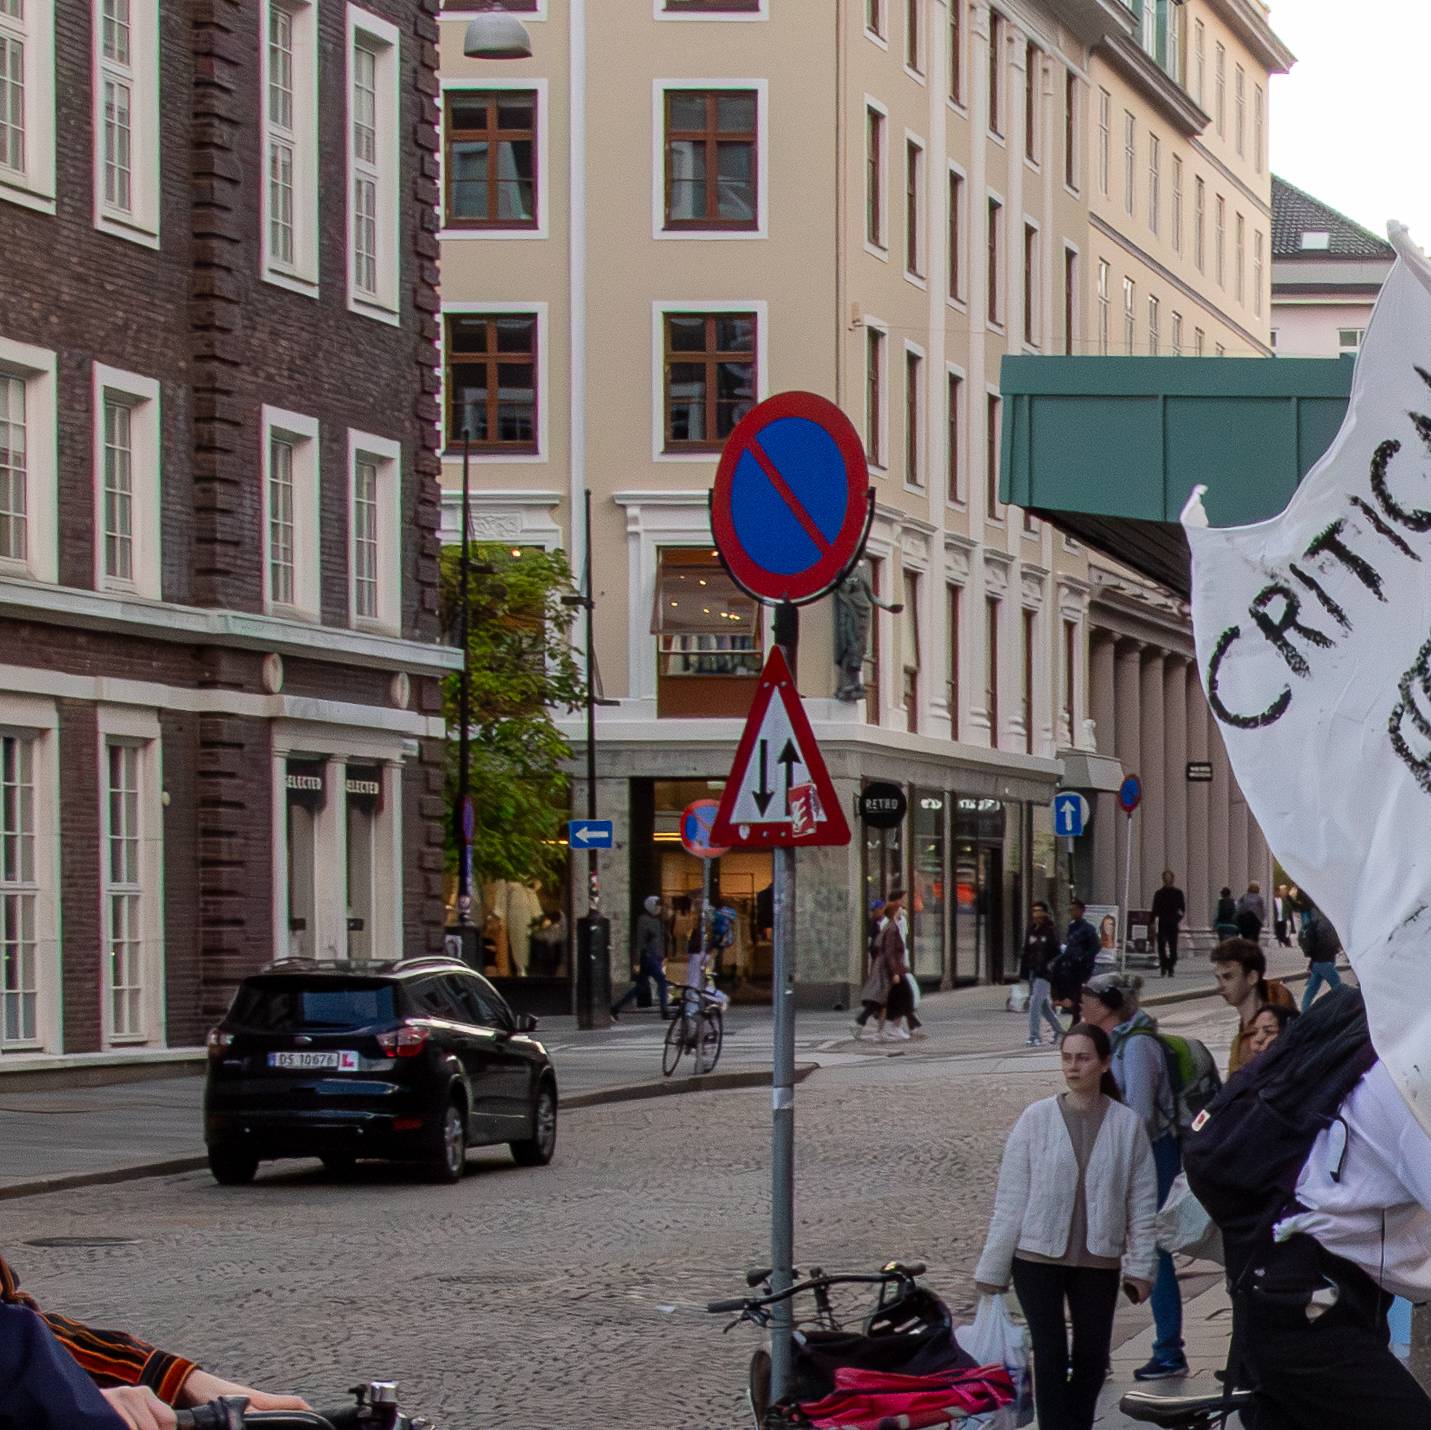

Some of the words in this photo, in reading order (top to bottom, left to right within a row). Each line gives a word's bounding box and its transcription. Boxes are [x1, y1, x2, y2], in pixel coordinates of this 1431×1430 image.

[286, 775, 322, 790] ELECTED
[346, 779, 379, 795] ELECTED
[865, 798, 899, 810] RETRO
[342, 1053, 354, 1067] L
